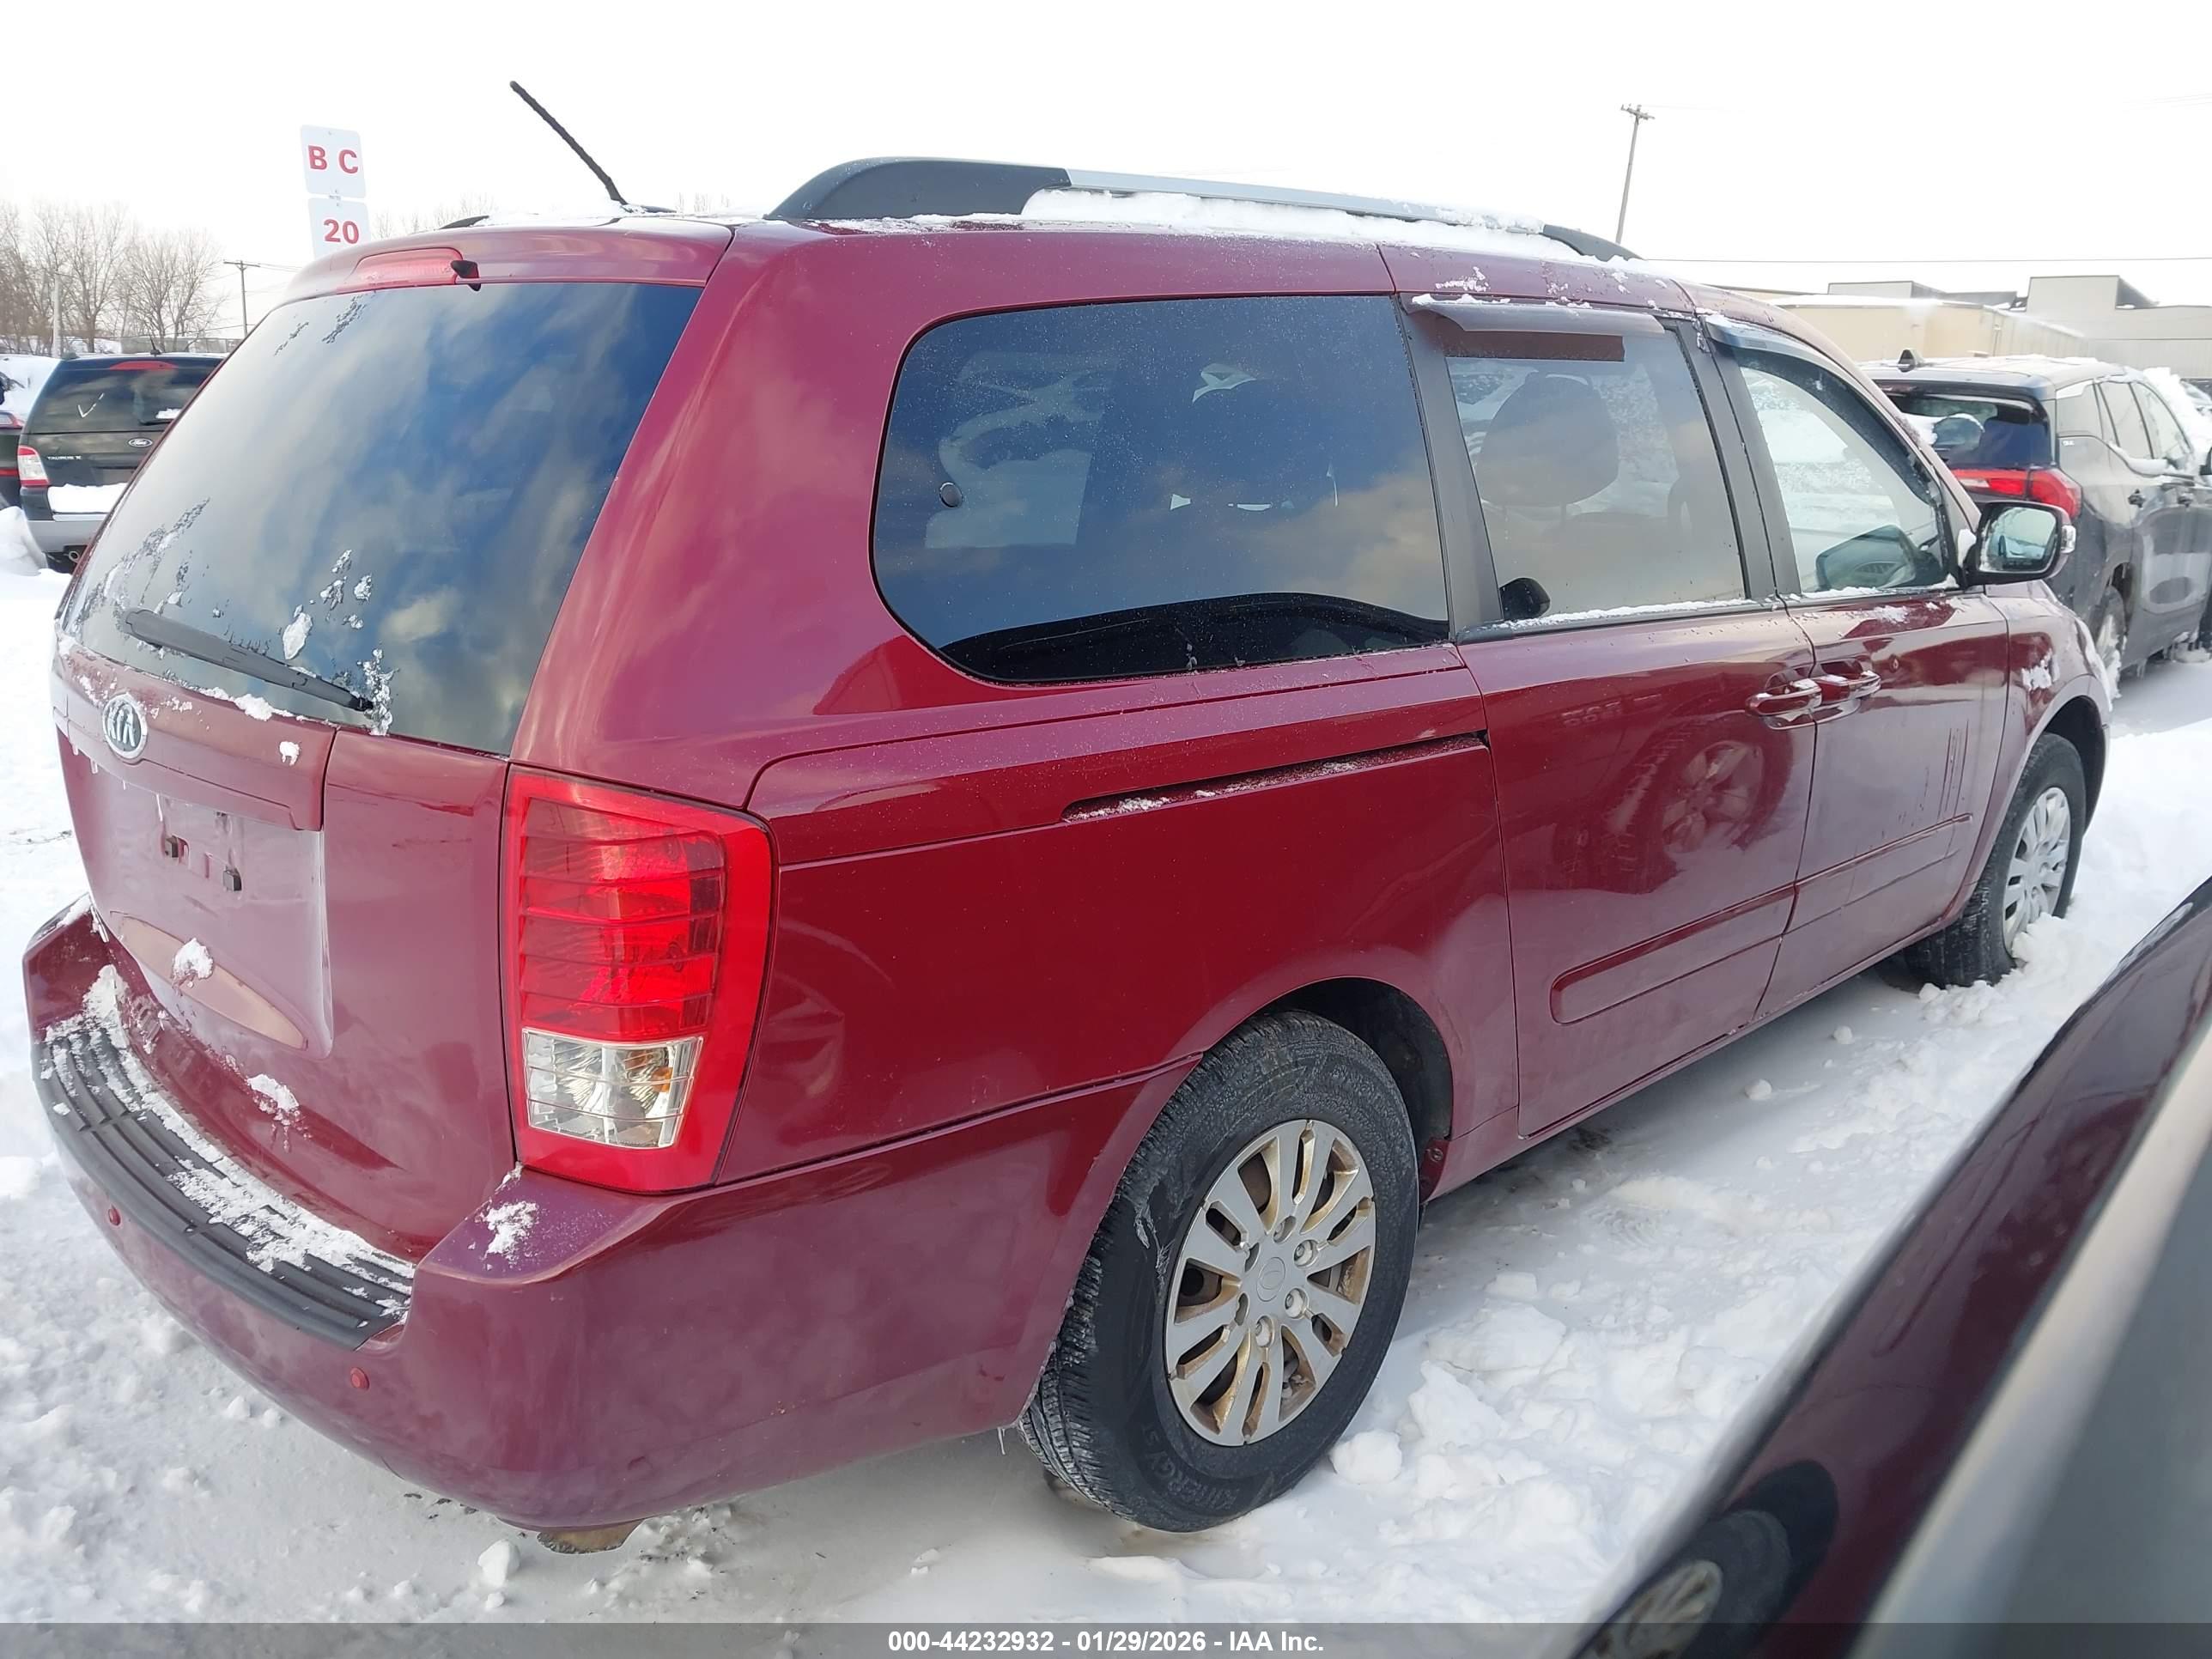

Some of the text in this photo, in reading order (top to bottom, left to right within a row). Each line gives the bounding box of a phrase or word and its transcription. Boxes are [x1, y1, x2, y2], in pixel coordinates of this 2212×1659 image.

[307, 145, 359, 174] B C
[323, 219, 360, 245] 20
